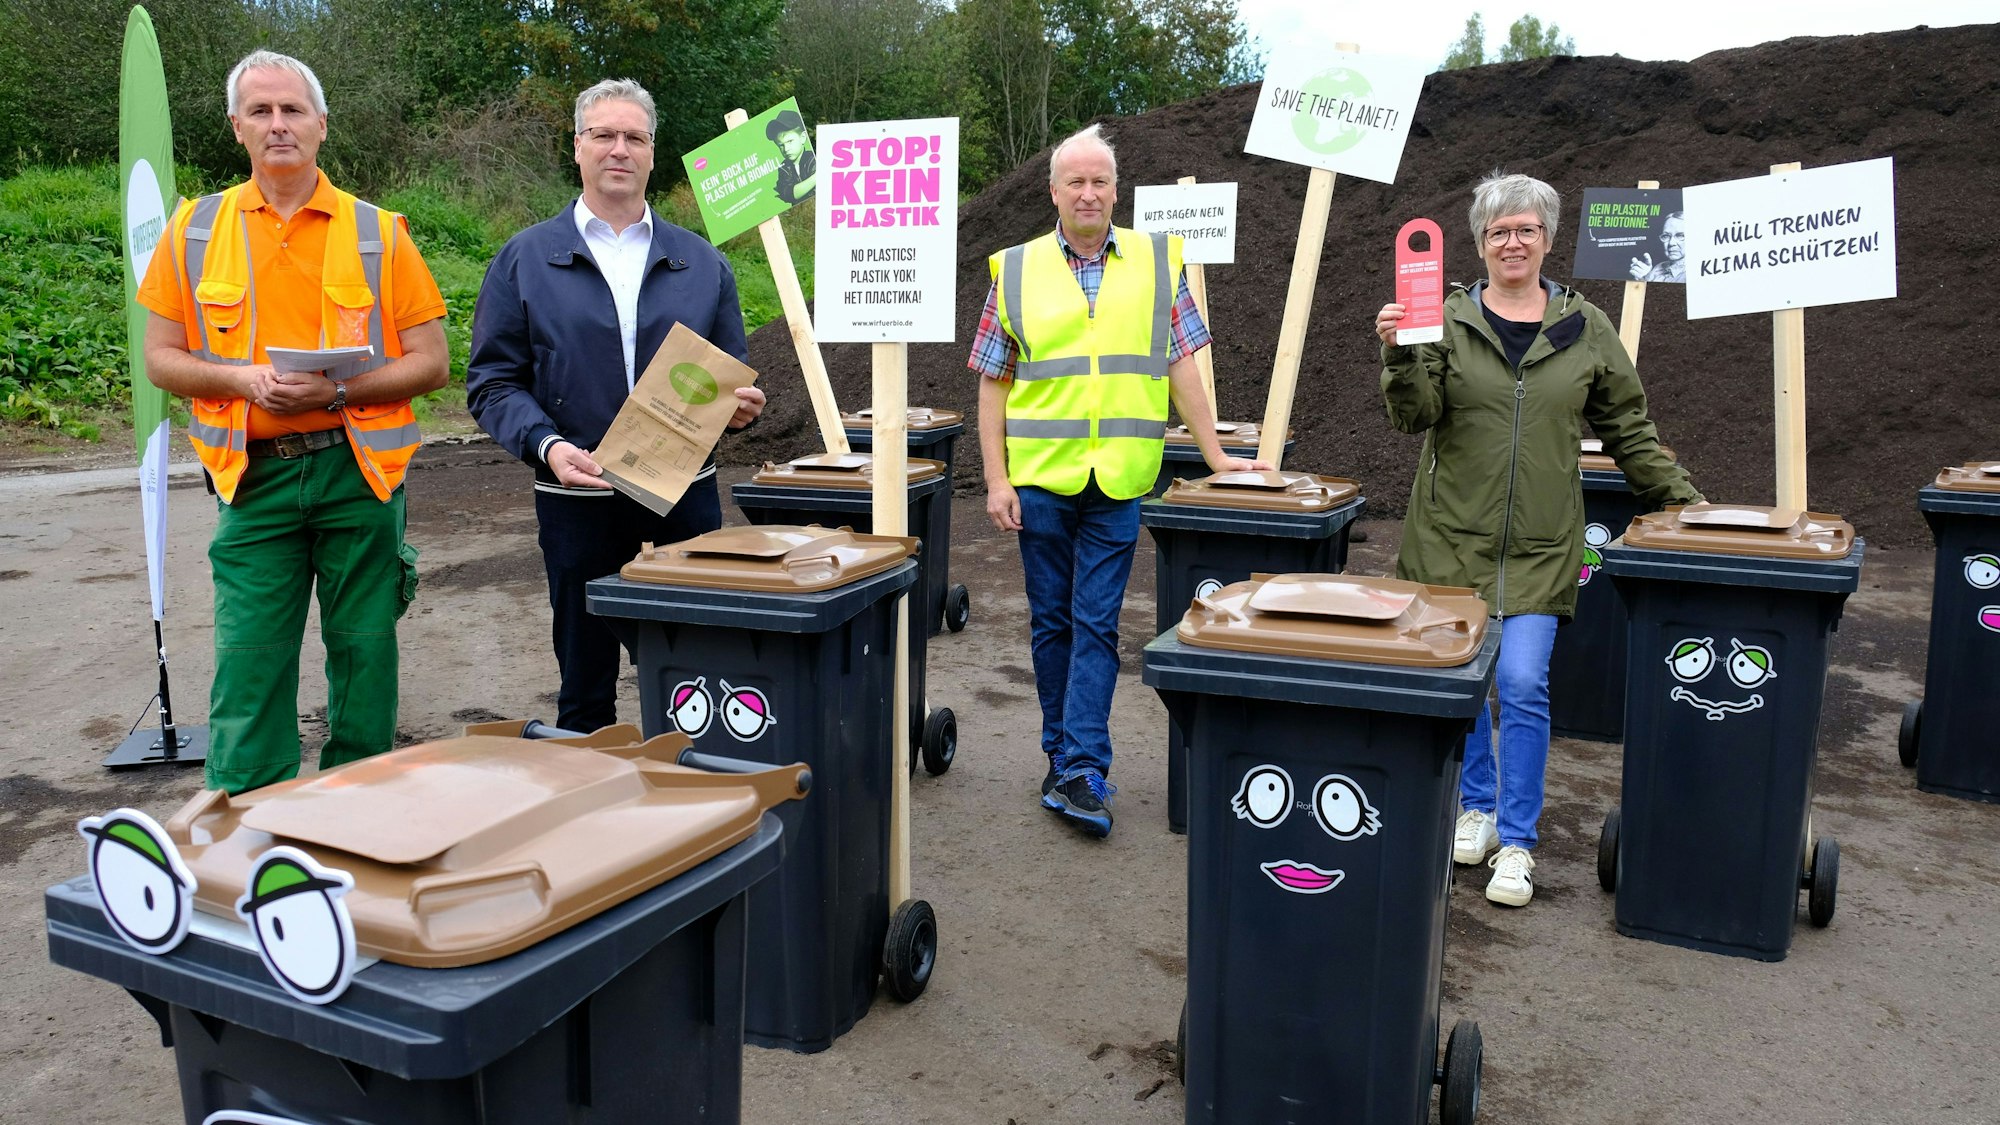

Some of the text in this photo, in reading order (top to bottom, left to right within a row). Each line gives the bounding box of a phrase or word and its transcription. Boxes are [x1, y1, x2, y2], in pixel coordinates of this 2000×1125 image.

[1271, 87, 1399, 131] SAVE THE PLANET!
[831, 135, 941, 168] STOP!
[721, 161, 744, 182] BOCK
[743, 153, 759, 169] AUF
[704, 180, 737, 206] PLASTIK
[736, 175, 748, 188] IM
[831, 167, 940, 206] KEIN
[831, 206, 940, 229] PLASTIK
[1144, 206, 1224, 221] WIR SAGEN NEIN
[1589, 203, 1660, 216] KEIN PLASTIK IN
[1588, 216, 1650, 228] DIE BIOTONNE.
[1714, 206, 1861, 246] MÜLL TRENNEN
[851, 248, 916, 262] NO PLASTICS!
[1700, 231, 1879, 277] KLIMA SCHÜTZEN!
[850, 269, 916, 283] PLASTIK YOK!
[844, 290, 922, 305] НЕТ ПЛАСТИКА!
[852, 319, 913, 328] www.wirfuerbio.de
